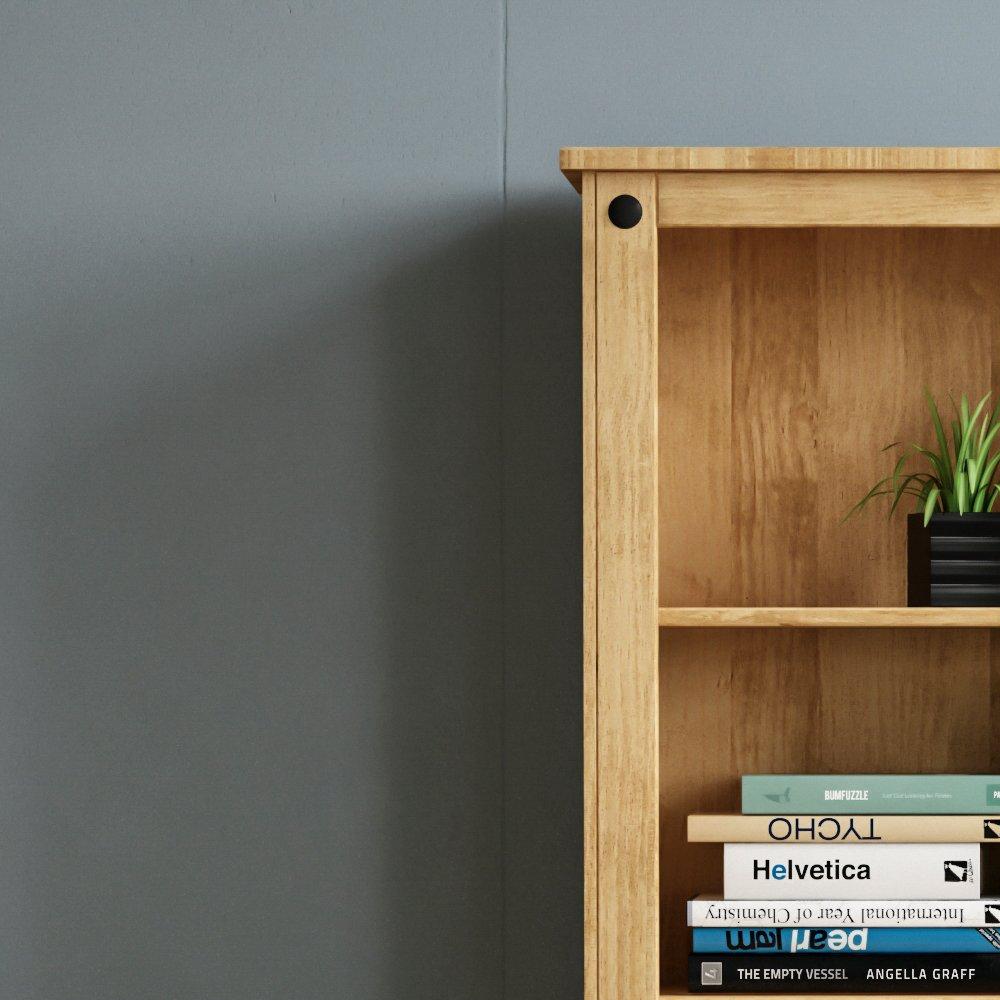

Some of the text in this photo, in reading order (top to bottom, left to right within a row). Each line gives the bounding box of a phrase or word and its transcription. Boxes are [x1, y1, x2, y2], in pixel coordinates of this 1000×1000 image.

[824, 789, 869, 801] BUMFUZZLE
[768, 817, 881, 841] TYCHO
[753, 859, 871, 880] Helvetica
[705, 905, 963, 923] International Year of Chemistry
[726, 928, 869, 953] pearl jam
[737, 968, 849, 980] THE EMPTY VESSEL
[866, 968, 976, 980] ANGELLA GRAFF
